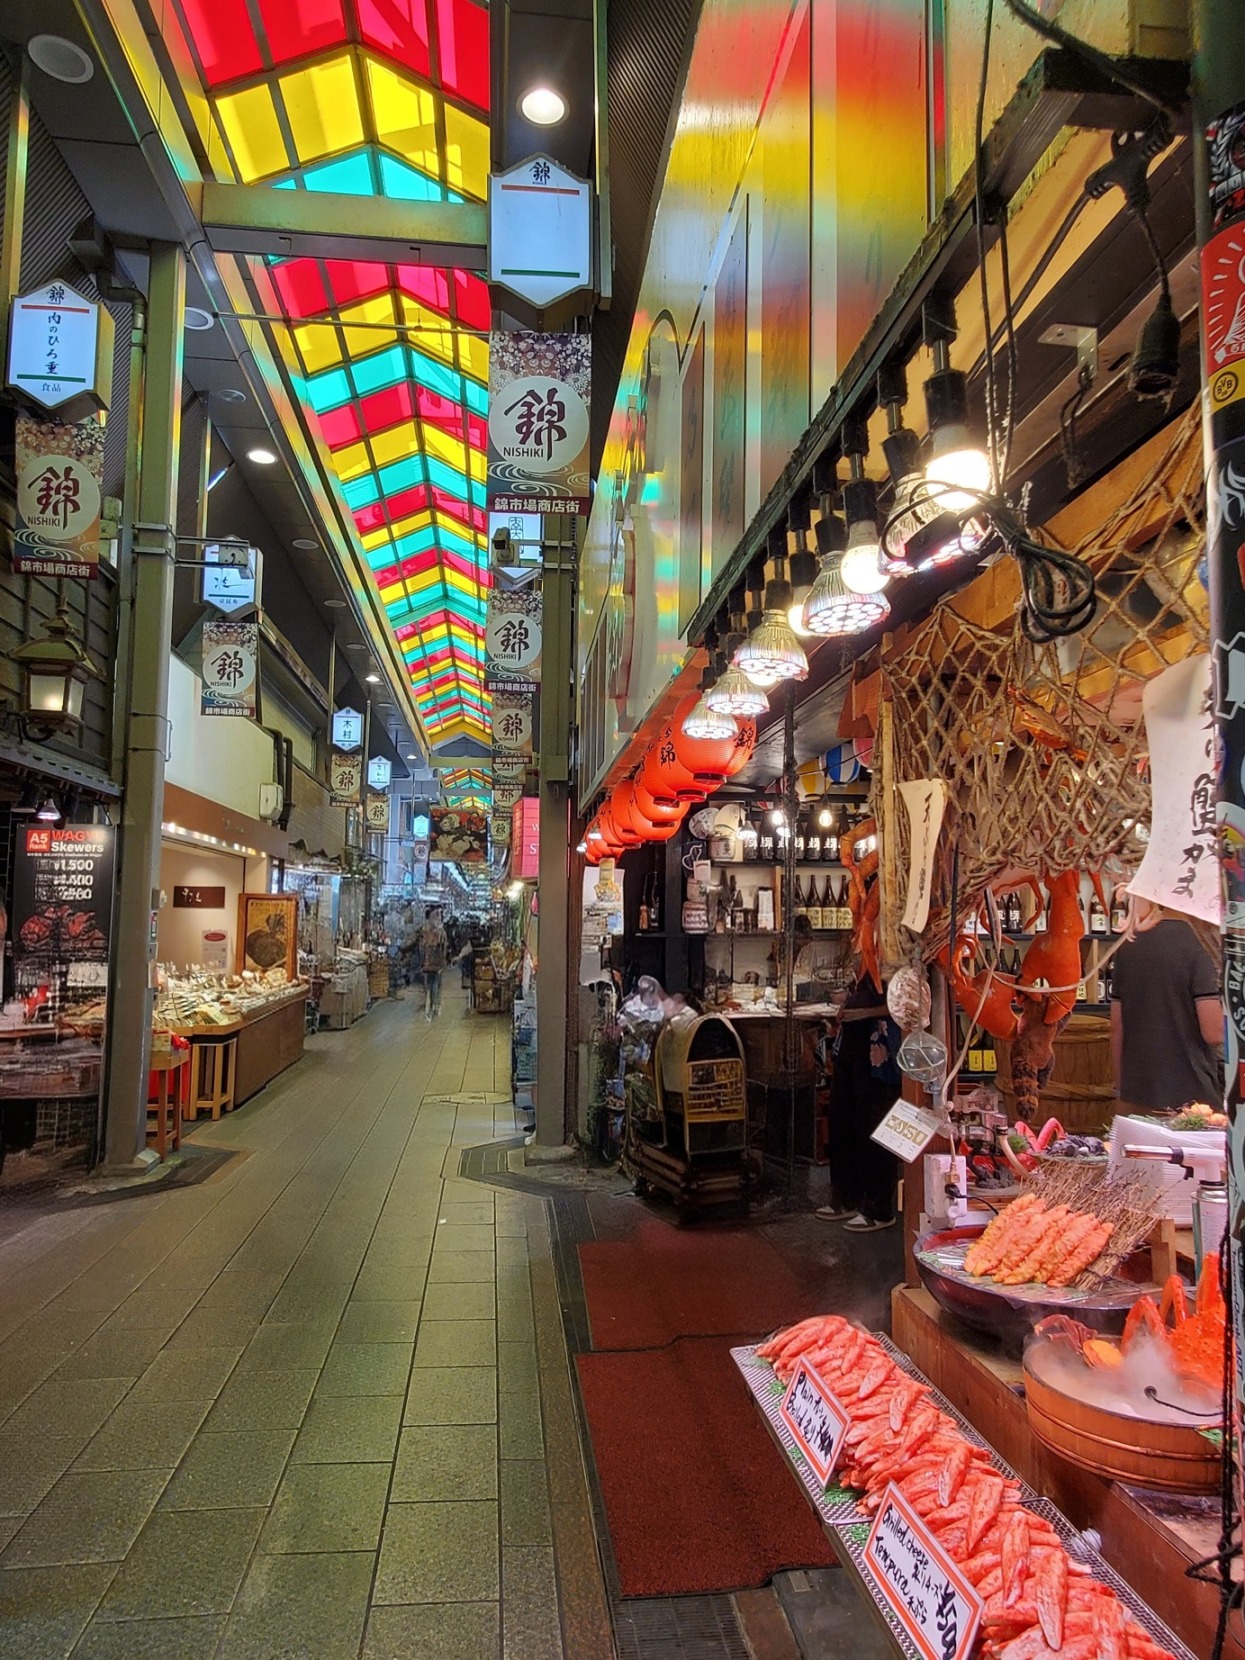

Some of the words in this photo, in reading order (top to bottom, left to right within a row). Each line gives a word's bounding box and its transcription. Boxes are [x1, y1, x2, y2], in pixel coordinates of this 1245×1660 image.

[529, 162, 551, 185] 錦
[504, 387, 567, 462] 錦
[503, 447, 544, 458] NISHIKI
[27, 466, 80, 531] 錦
[494, 497, 580, 514] 錦市場商店街
[27, 516, 60, 527] NISHIKI
[20, 560, 91, 577] 錦市場商店街
[494, 620, 530, 661] 錦
[211, 650, 244, 690] 錦
[343, 720, 352, 739] 木村
[498, 713, 524, 742] 錦
[336, 770, 354, 791] 錦
[30, 832, 49, 844] A5
[51, 841, 104, 853] Skewers
[794, 1370, 814, 1405] Plain
[882, 1502, 907, 1547] Grilled
[906, 1536, 929, 1570] cheese
[875, 1535, 911, 1597] Tempura
